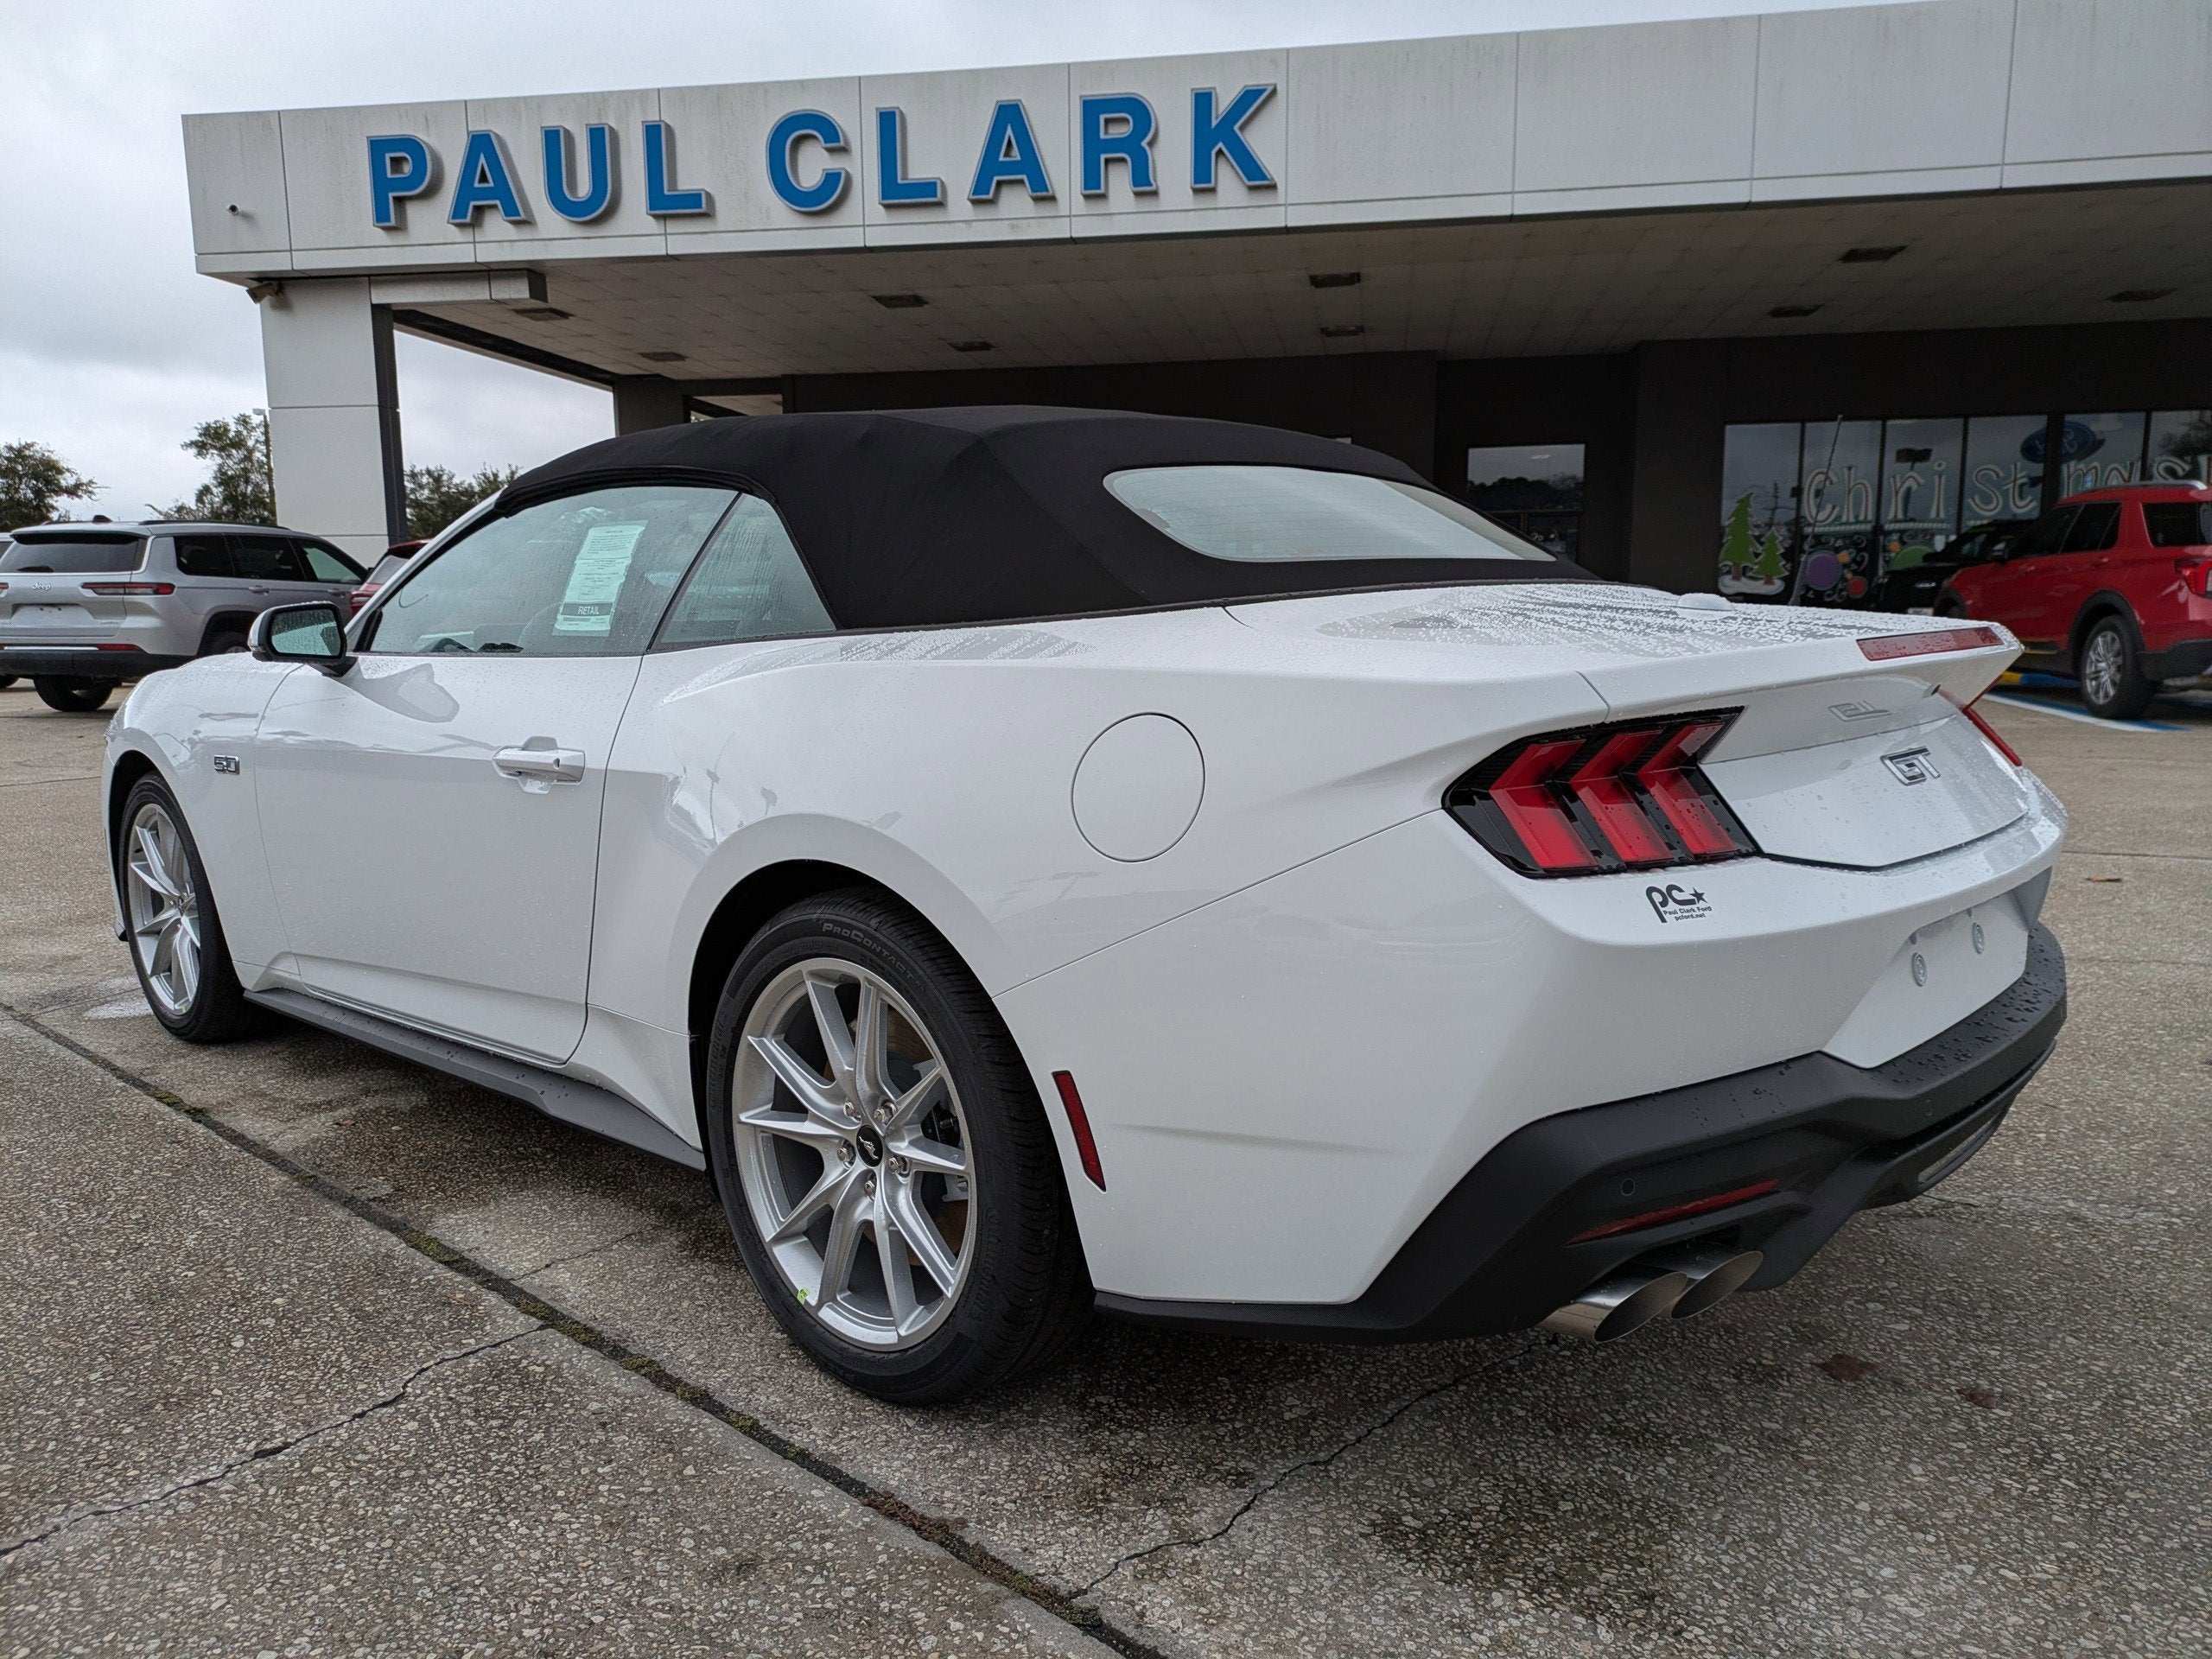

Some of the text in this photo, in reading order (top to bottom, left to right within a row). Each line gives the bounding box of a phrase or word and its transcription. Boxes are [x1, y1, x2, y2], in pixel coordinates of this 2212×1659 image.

[368, 83, 1277, 228] PAUL CLARK
[32, 582, 51, 591] Jeep
[577, 606, 600, 614] RETAIL
[1880, 746, 1941, 786] GT
[1675, 912, 1706, 921] pcford.net
